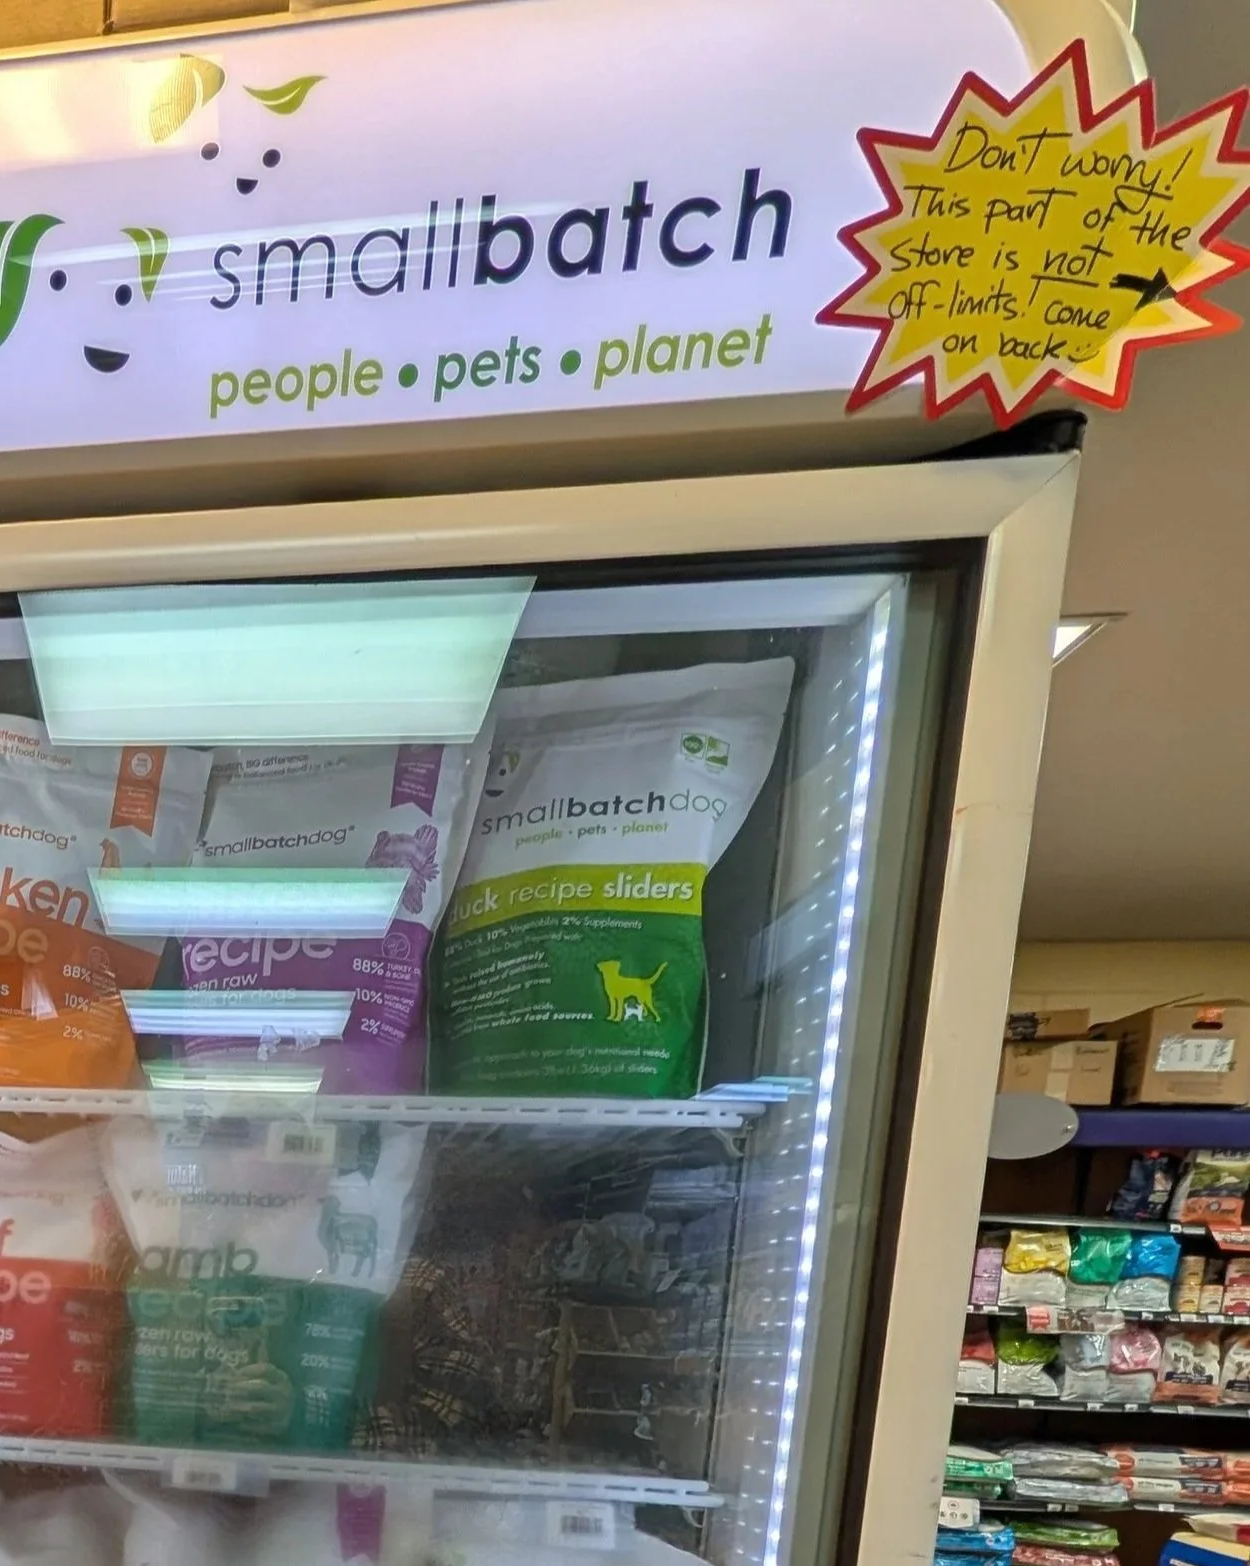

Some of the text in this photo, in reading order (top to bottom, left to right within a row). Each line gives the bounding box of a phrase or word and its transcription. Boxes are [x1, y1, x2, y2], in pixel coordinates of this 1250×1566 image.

[1060, 148, 1193, 214] worry!
[903, 183, 1192, 251] This part of the
[209, 167, 793, 310] smallbatch
[993, 243, 1019, 271] is
[1044, 240, 1113, 278] not
[943, 332, 1067, 360] on back
[209, 314, 772, 419] people pets planet
[15, 747, 35, 758] food
[482, 787, 728, 838] smallbatchdog
[514, 819, 670, 851] people pets planet
[507, 875, 594, 909] recipe
[602, 870, 694, 902] sliders
[561, 915, 643, 931] 2% Supplements
[181, 930, 337, 979] recipe
[62, 964, 92, 985] 88%
[352, 957, 385, 977] 88%
[221, 971, 259, 990] raw
[63, 991, 90, 1012] 10%
[355, 987, 383, 1005] 10%
[360, 1017, 381, 1035] 2%
[523, 1011, 595, 1023] food sources.
[62, 1025, 84, 1041] 2%
[642, 1047, 671, 1060] needs
